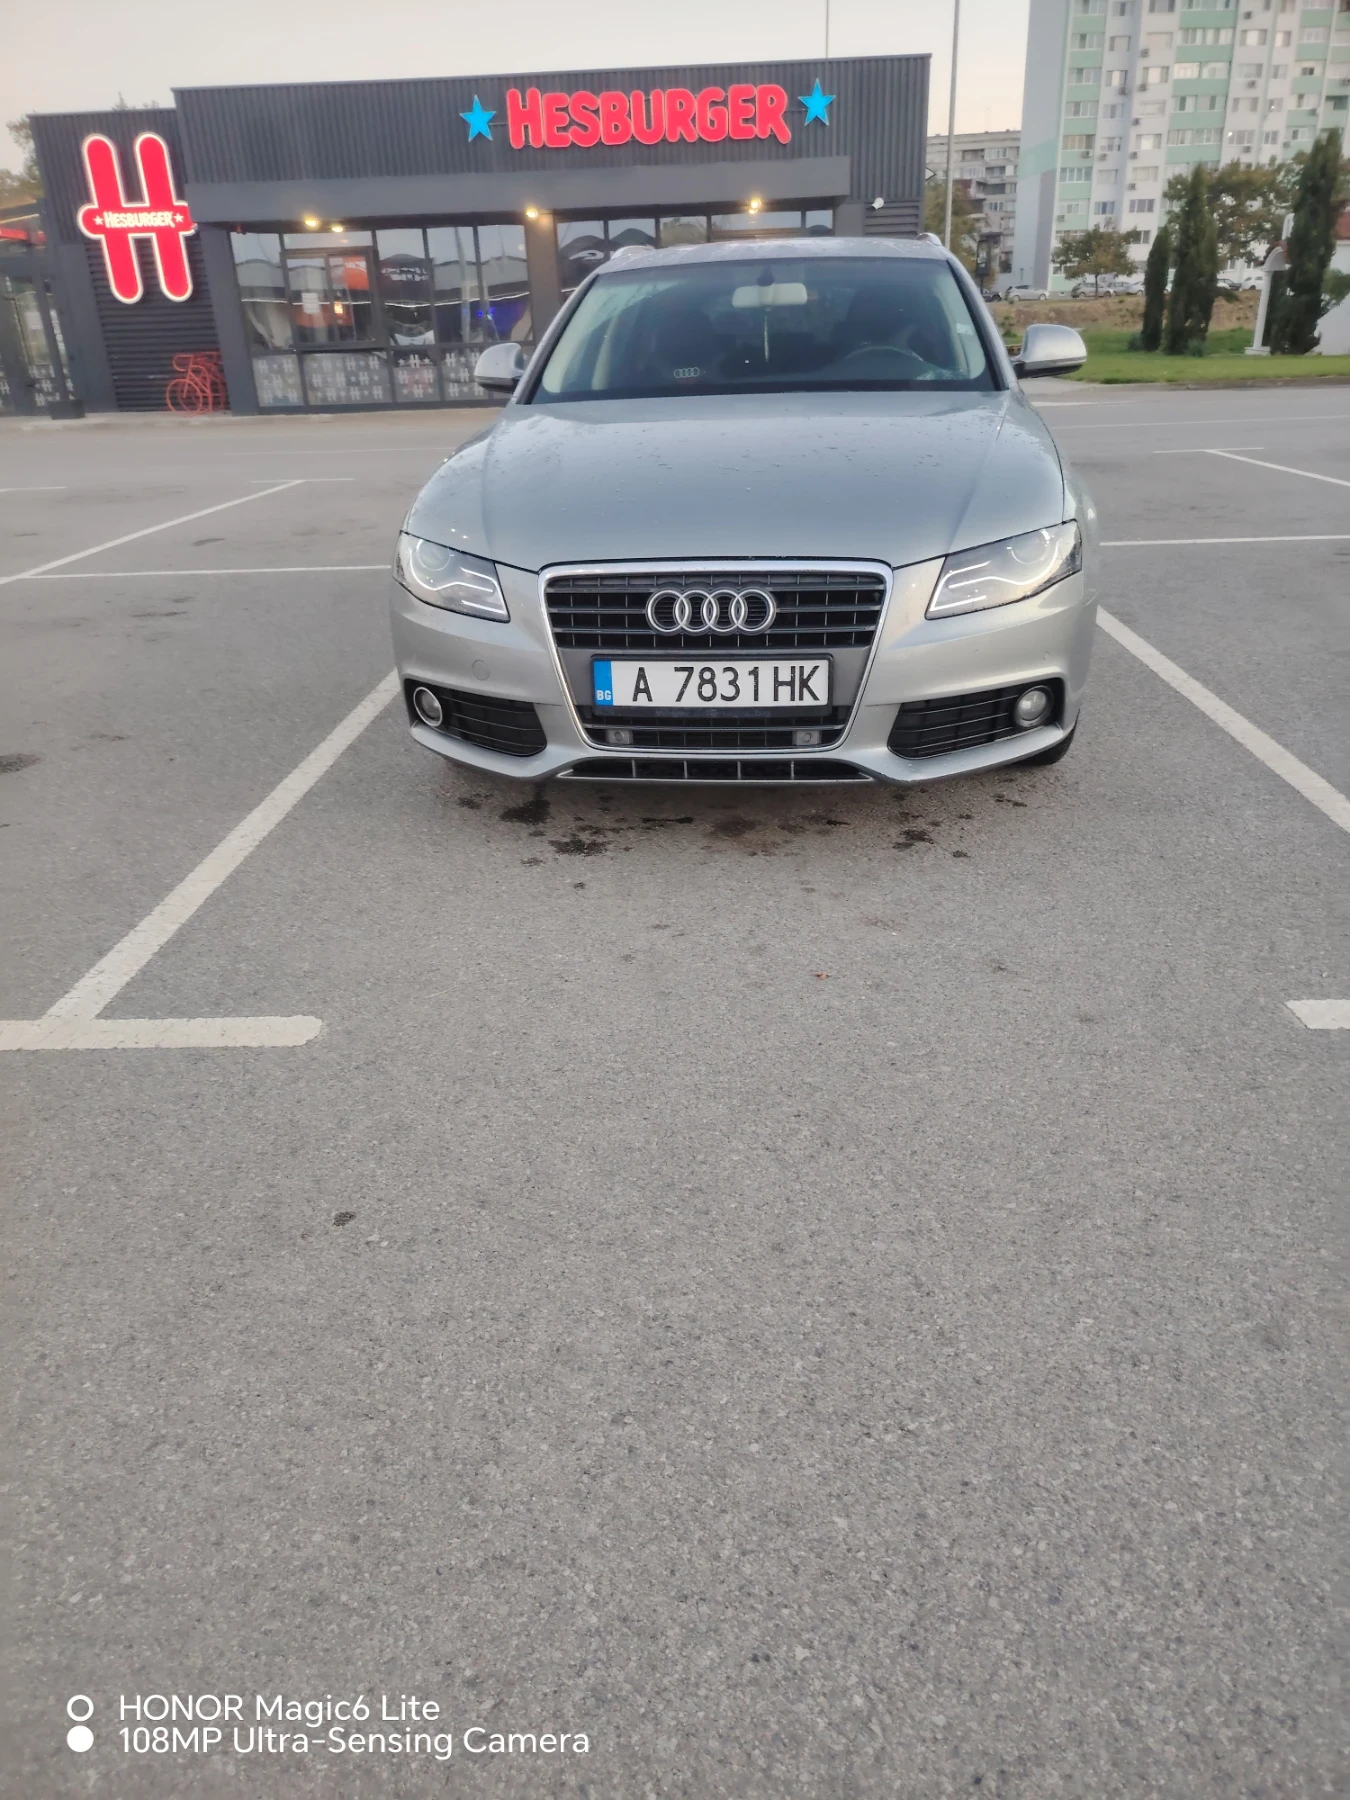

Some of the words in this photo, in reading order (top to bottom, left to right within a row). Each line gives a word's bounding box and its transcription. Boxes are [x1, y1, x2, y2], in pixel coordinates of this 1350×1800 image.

[506, 84, 792, 149] HESBURGER
[103, 211, 175, 228] HESBURGER
[596, 689, 612, 700] BG
[632, 667, 653, 702] A
[674, 666, 760, 702] 7831
[773, 665, 820, 702] HK
